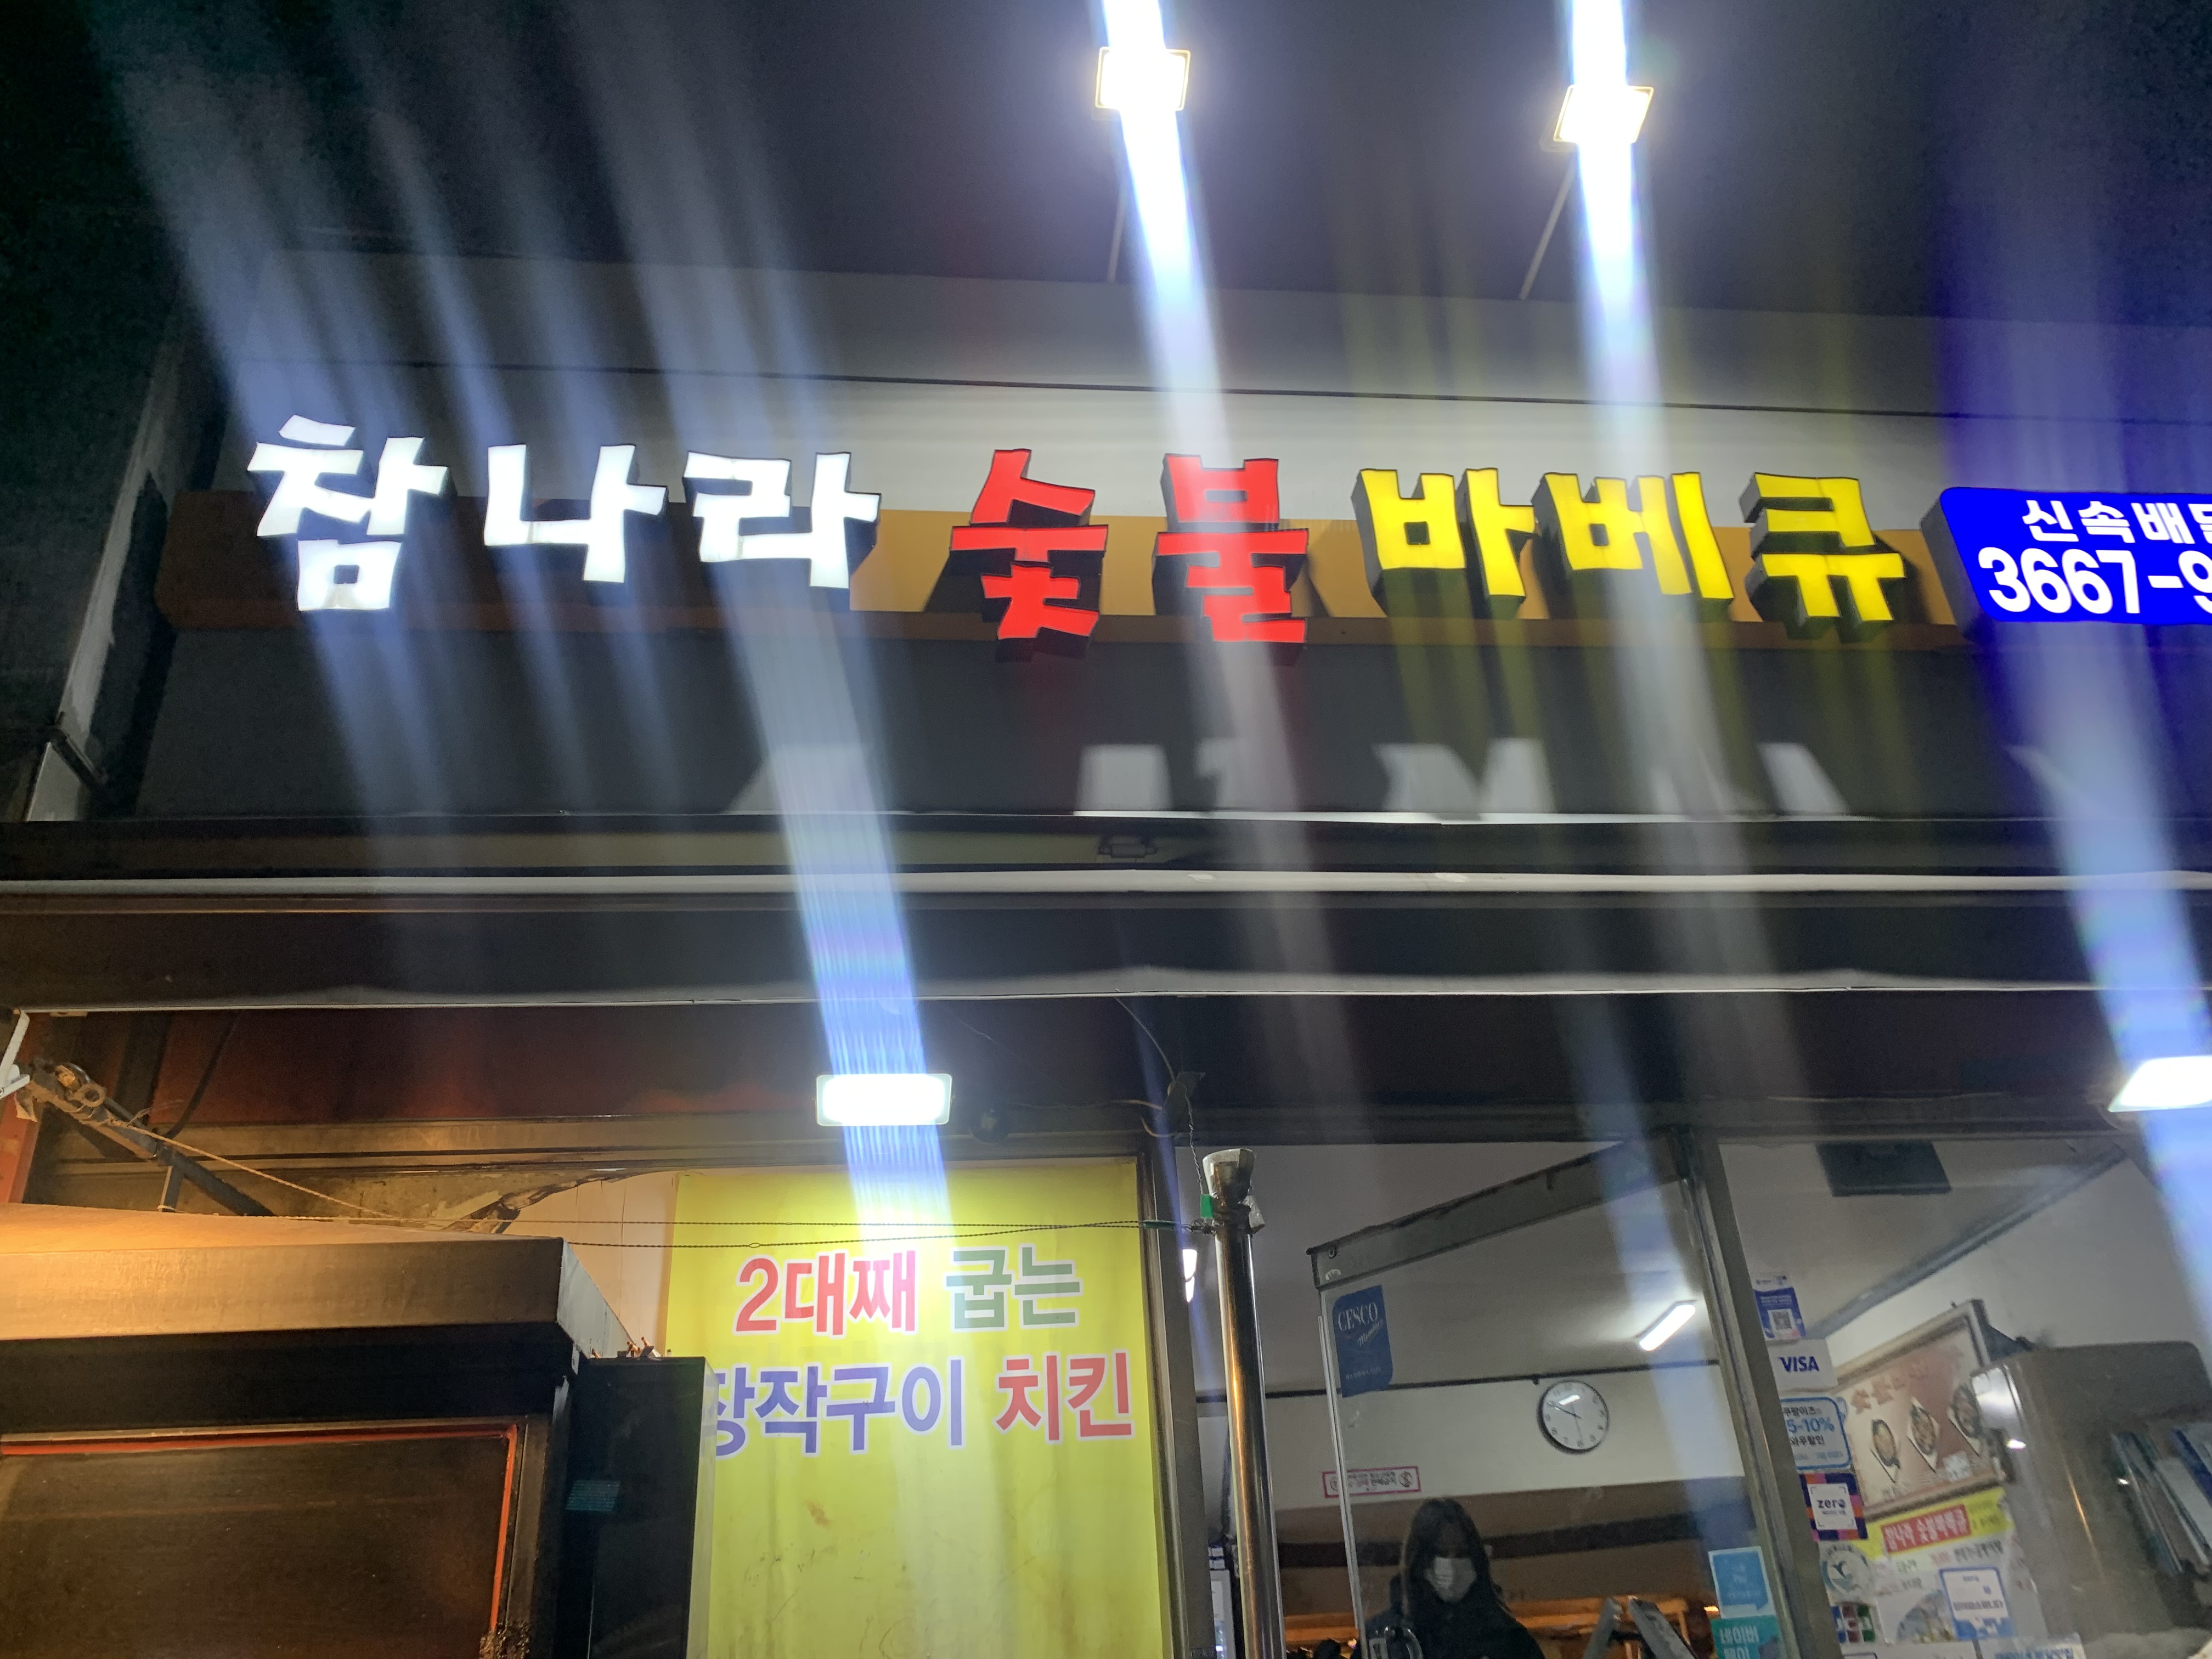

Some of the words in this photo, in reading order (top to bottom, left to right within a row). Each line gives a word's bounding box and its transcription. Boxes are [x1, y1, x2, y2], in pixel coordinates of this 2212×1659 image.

[247, 415, 881, 611] 참나라
[950, 448, 1309, 642] 숯불
[1357, 468, 1904, 621] 바베큐
[736, 1250, 916, 1335] 2대째
[946, 1246, 1080, 1329] 굽는
[1338, 1302, 1379, 1331] CESCO
[1779, 1356, 1820, 1372] VISA
[996, 1352, 1132, 1441] 치킨
[1817, 1499, 1846, 1509] zero
[1719, 1625, 1759, 1645] 네이버
